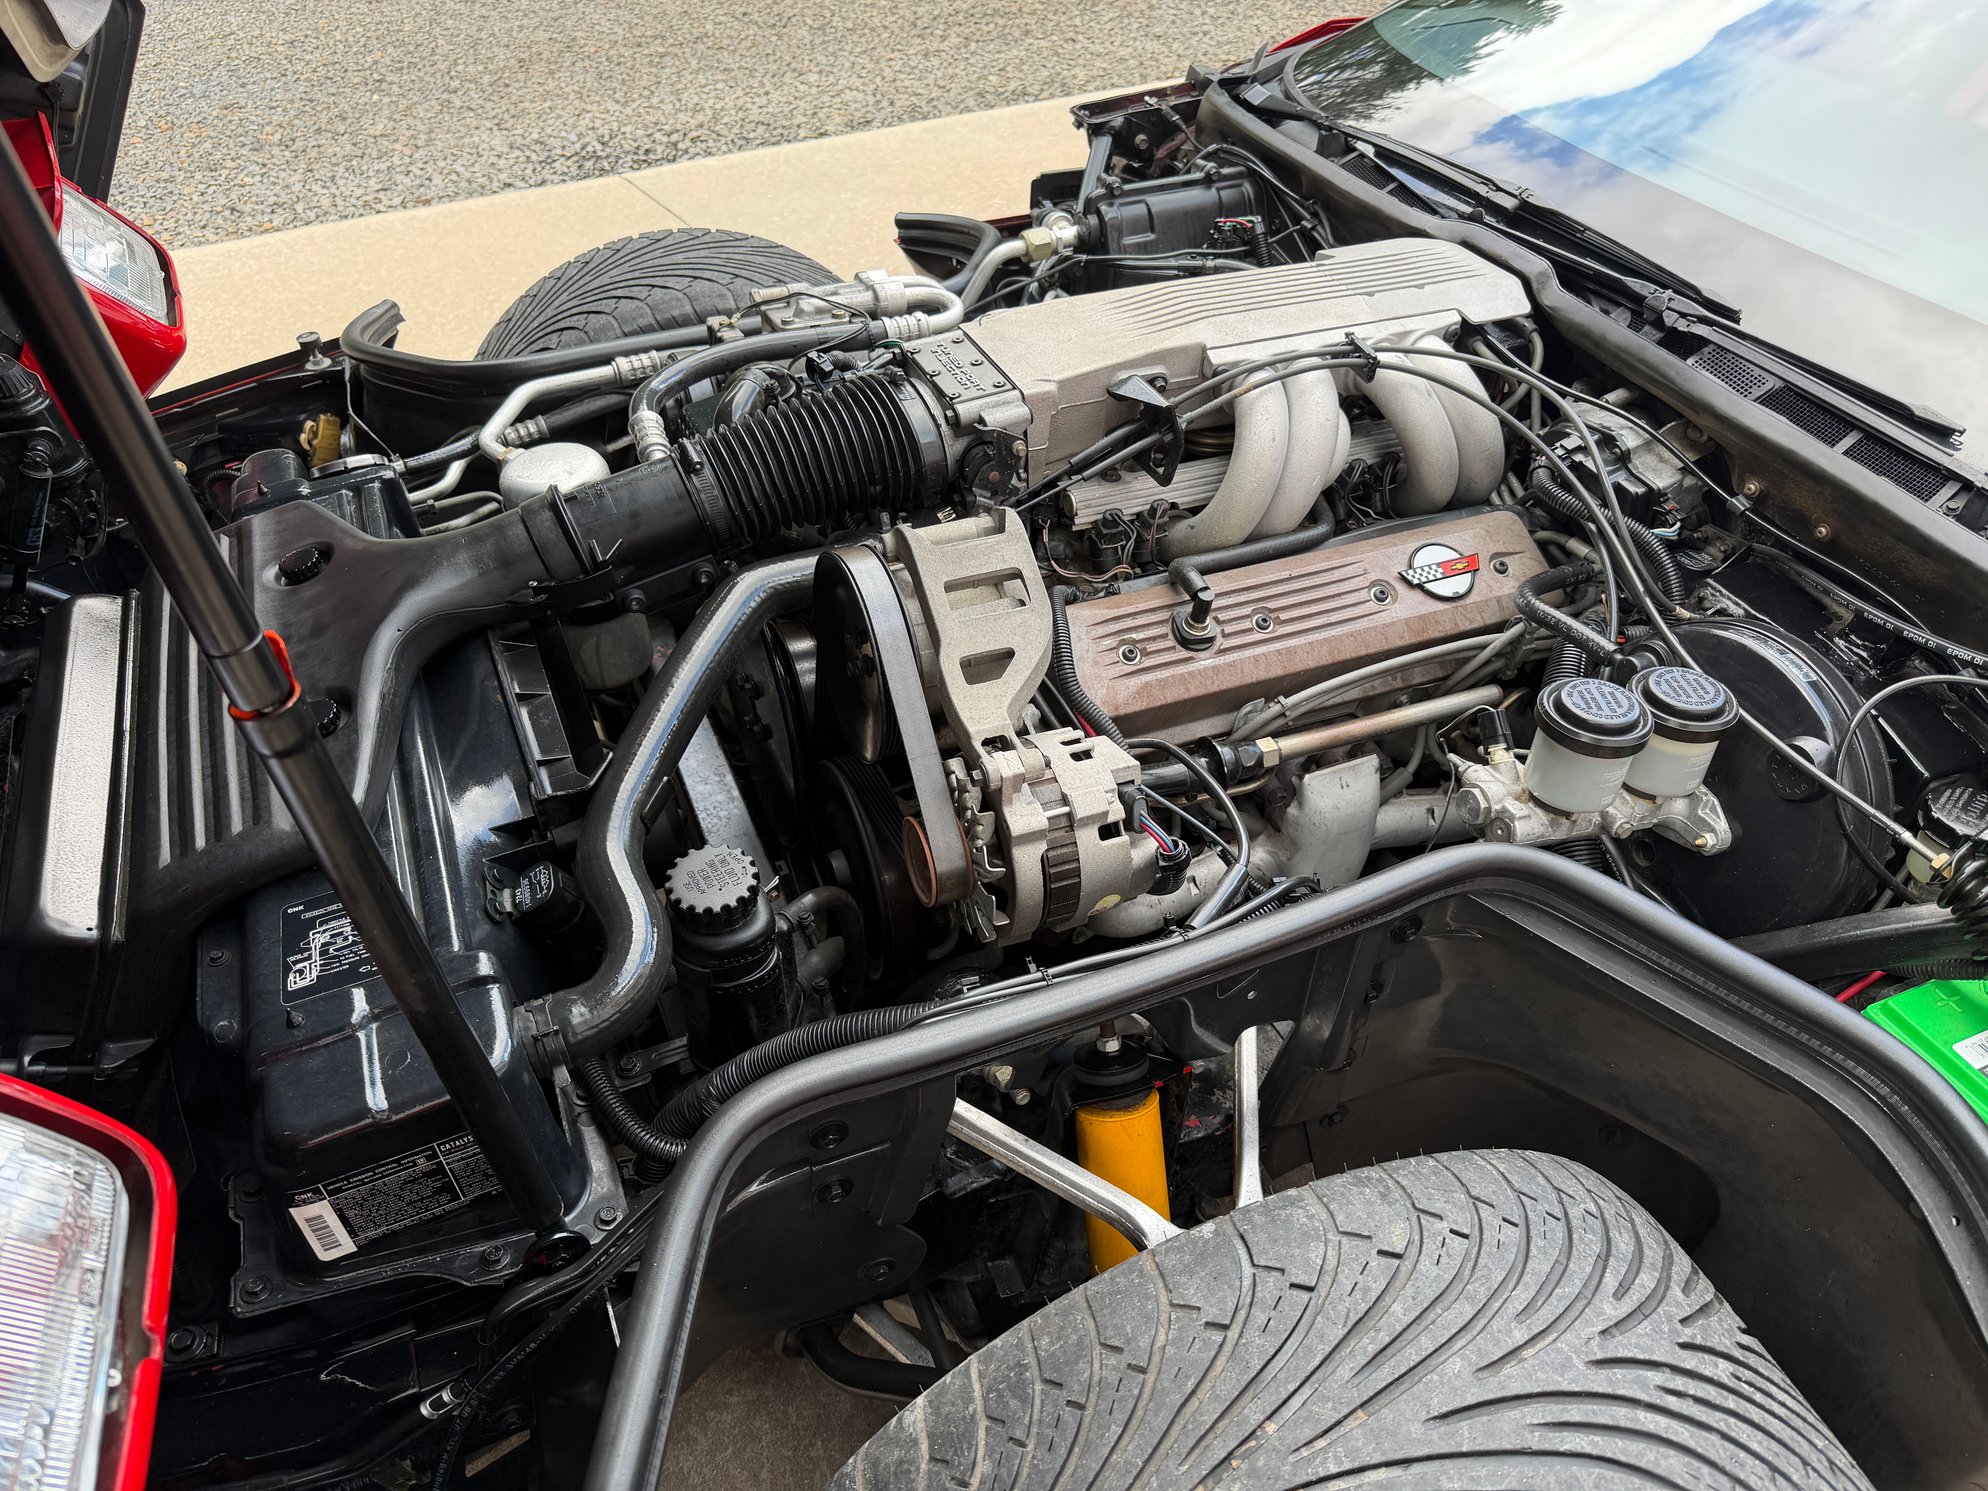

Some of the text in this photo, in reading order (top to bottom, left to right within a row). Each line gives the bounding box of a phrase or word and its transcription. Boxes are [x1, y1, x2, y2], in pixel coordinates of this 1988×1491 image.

[931, 348, 970, 390] INJECTION
[936, 341, 986, 392] TUNED PORT
[714, 853, 742, 887] FLUID ONLY
[728, 851, 745, 865] OPEN
[686, 870, 706, 894] APPROVED
[697, 868, 717, 889] POWER
[705, 859, 730, 888] STEERING
[683, 880, 695, 893] USE
[286, 904, 305, 913] CNK
[441, 1135, 474, 1151] CATALYS
[348, 1171, 374, 1181] EMISSION
[374, 1162, 398, 1172] CONTROL
[399, 1151, 433, 1163] INFORMATION
